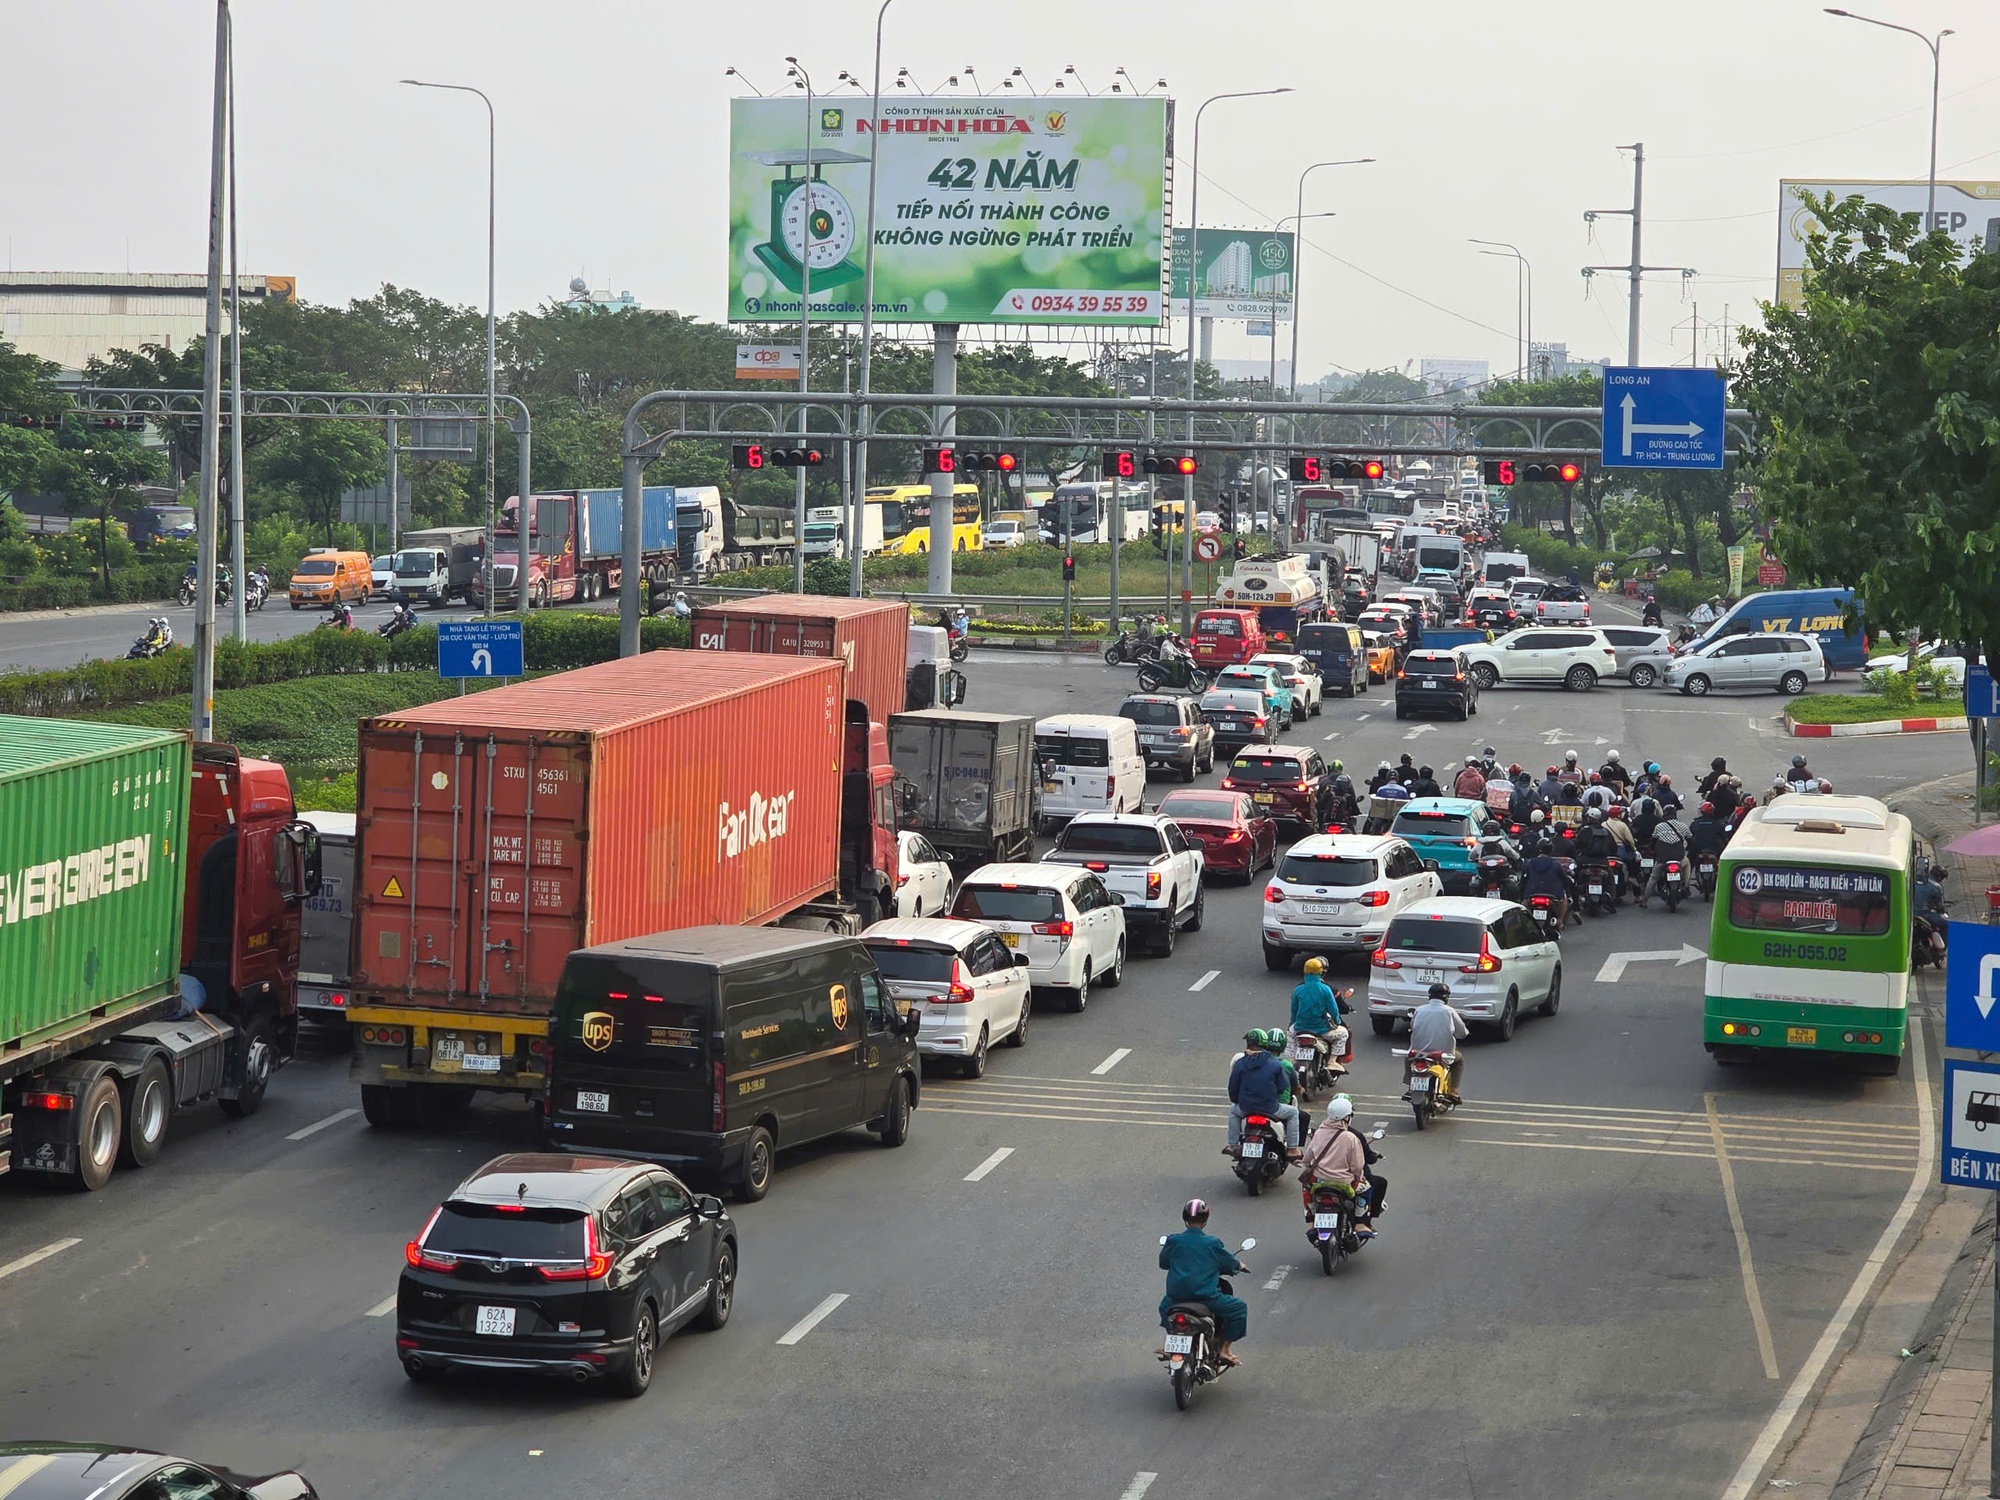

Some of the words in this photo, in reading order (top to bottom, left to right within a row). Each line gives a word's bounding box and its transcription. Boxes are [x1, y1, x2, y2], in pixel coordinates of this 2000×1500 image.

[912, 108, 921, 116] TY
[922, 108, 944, 116] TNHH
[927, 157, 979, 192] 42
[983, 150, 1081, 192] NĂM
[896, 198, 933, 220] TIẾP
[938, 198, 974, 220] NỐI
[980, 201, 1044, 220] THÀNH
[1049, 202, 1110, 221] CÔNG
[874, 226, 944, 246] KHÔNG
[949, 227, 1020, 247] NGỪNG
[1026, 228, 1077, 247] PHÁT
[1081, 224, 1133, 248] TRIỂN
[1031, 295, 1075, 312] 0934
[1077, 296, 1099, 312] 39
[1102, 297, 1123, 312] 55
[1126, 296, 1148, 313] 39
[1609, 376, 1634, 385] LONG
[1636, 376, 1650, 385] AN
[1648, 438, 1673, 449] ĐƯỜNG
[1674, 441, 1688, 449] CAO
[1689, 438, 1703, 449] TỐC
[748, 445, 762, 468] 6
[938, 449, 954, 472] 6
[1646, 452, 1661, 460] HCM
[1667, 452, 1690, 461] TRUNG
[1117, 453, 1133, 476] 6
[1305, 458, 1319, 481] 6
[1500, 460, 1513, 484] 6
[1238, 592, 1274, 601] 50H-124.29
[700, 634, 724, 650] CAI
[782, 638, 797, 647] CAIU
[803, 639, 824, 649] 320953
[503, 766, 525, 779] STXU
[537, 768, 569, 782] 456361
[537, 782, 558, 795] 45G1
[493, 850, 510, 862] TARE
[491, 878, 504, 888] NET
[1737, 872, 1758, 890] 622
[1774, 875, 1790, 889] CHỢ
[1809, 875, 1829, 891] RẠCH
[1830, 873, 1849, 890] KIẾN
[1853, 876, 1868, 892] TÂN
[1868, 877, 1883, 893] LÂN
[490, 891, 502, 903] CU.
[505, 892, 521, 904] CAP.
[305, 898, 342, 913] 469.73
[1784, 900, 1812, 922] RẠCH
[1812, 898, 1837, 920] KIẾN
[1763, 942, 1847, 961] 62H-055.02
[834, 998, 846, 1023] ups
[585, 1023, 611, 1045] ups
[763, 1023, 779, 1036] Services
[443, 1041, 459, 1050] 51R
[584, 1093, 603, 1102] 50LD
[581, 1101, 605, 1111] 198.60
[1950, 1152, 1980, 1180] BẾN
[486, 1308, 506, 1321] 62A
[479, 1320, 512, 1334] 132.28
